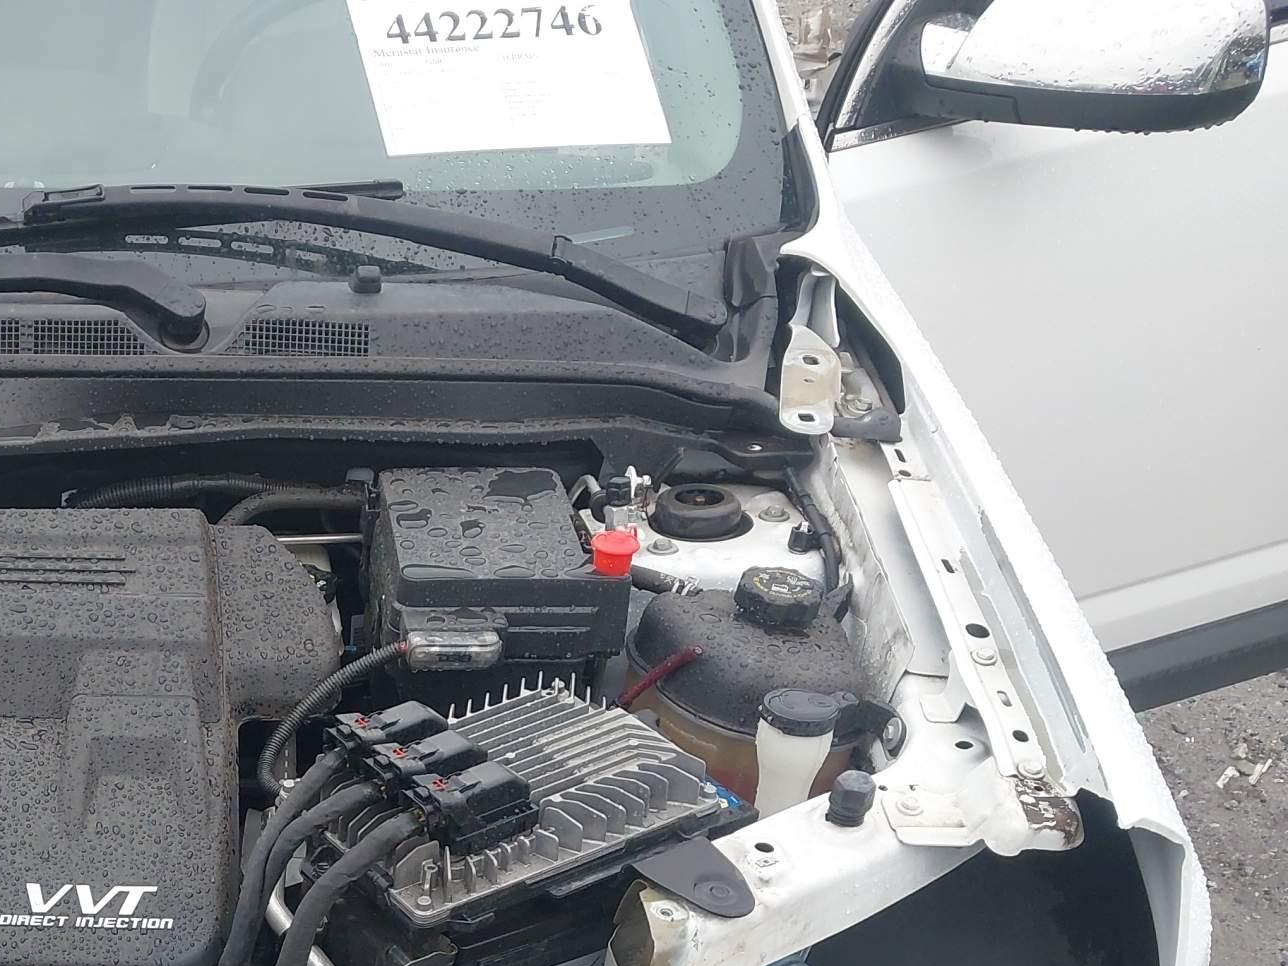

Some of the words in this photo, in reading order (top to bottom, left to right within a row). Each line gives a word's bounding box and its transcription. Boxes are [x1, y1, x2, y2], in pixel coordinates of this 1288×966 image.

[386, 5, 603, 44] 44222746
[26, 882, 158, 915] VVT
[75, 916, 174, 929] INJECTION
